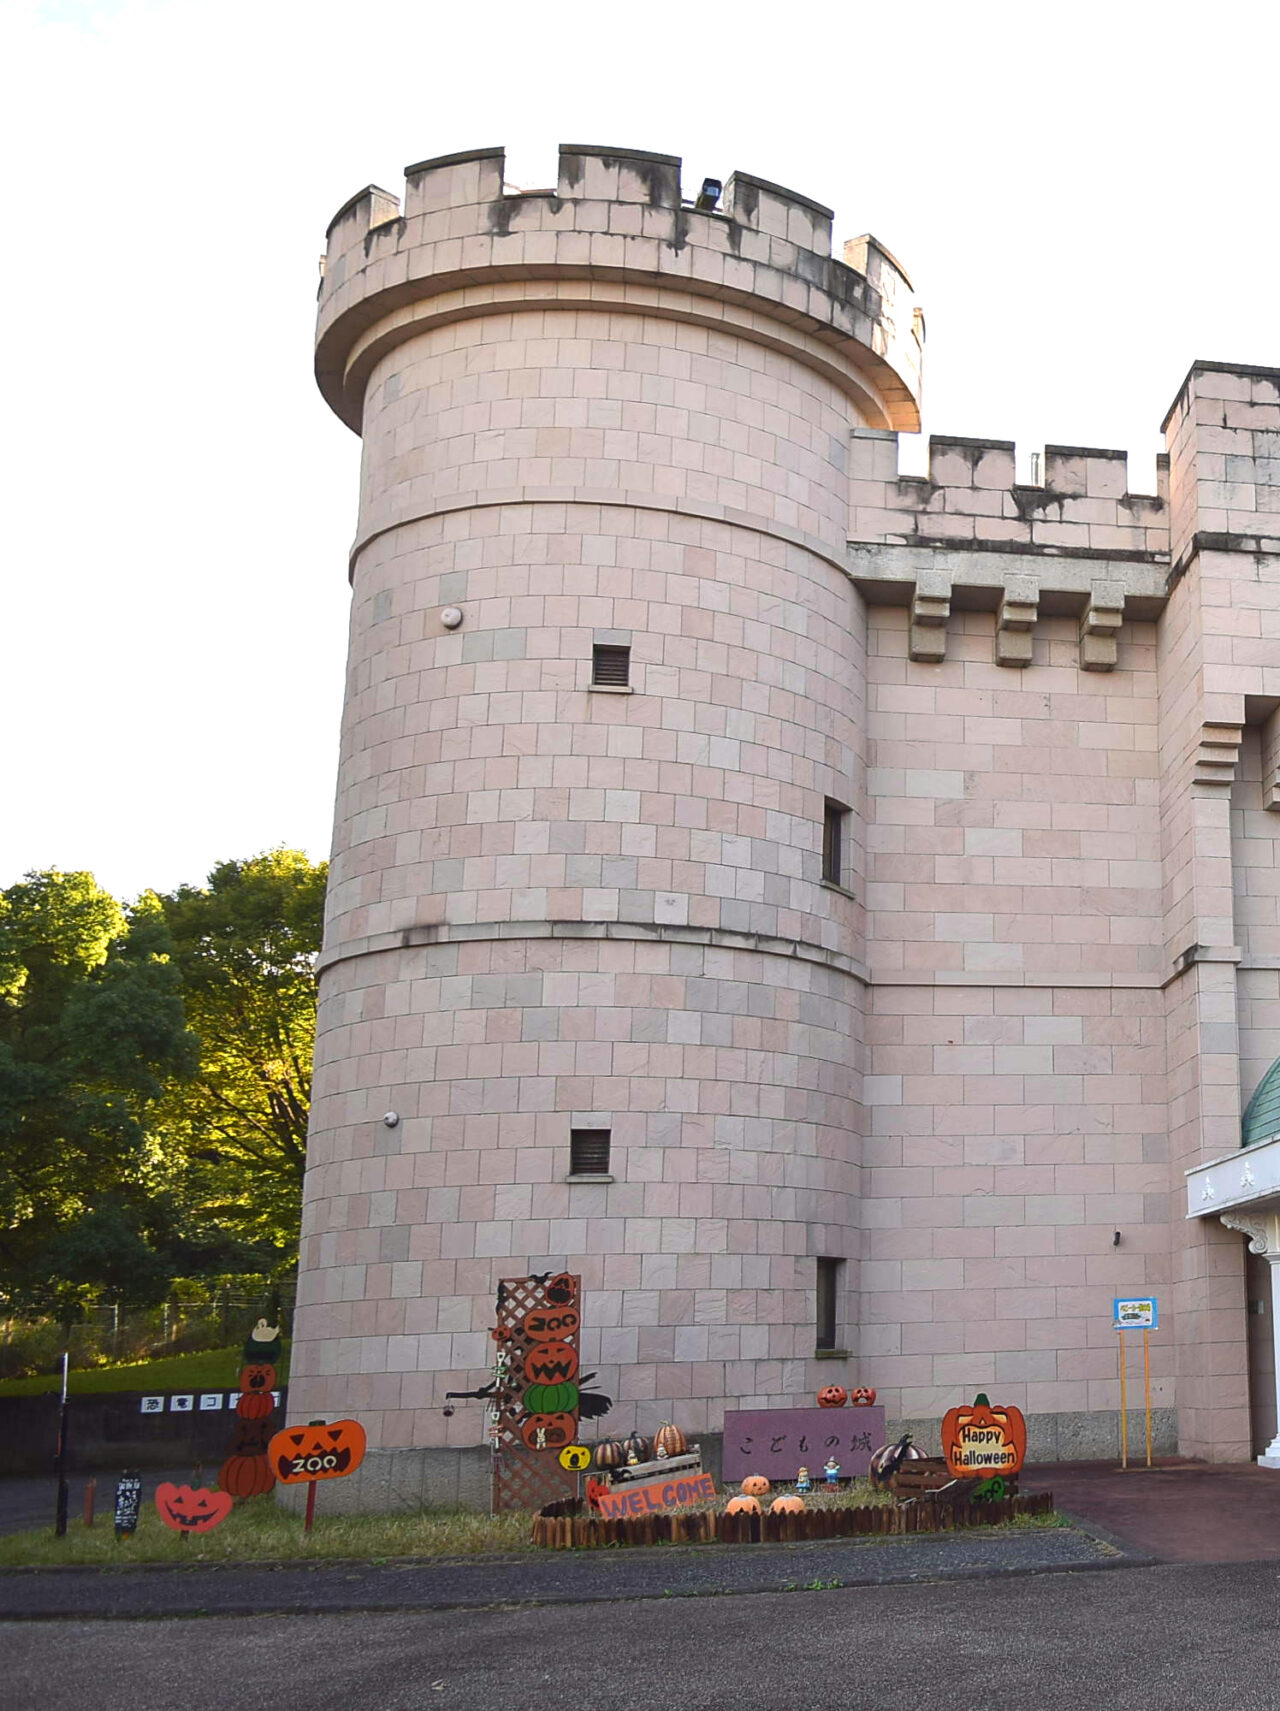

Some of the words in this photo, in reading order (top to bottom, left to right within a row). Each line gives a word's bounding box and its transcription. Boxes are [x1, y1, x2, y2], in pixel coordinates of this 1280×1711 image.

[739, 1431, 873, 1454] こどもの城
[962, 1427, 1002, 1444] Happy
[292, 1455, 337, 1473] ZOO
[954, 1450, 1015, 1466] Halloween
[601, 1478, 714, 1518] WELCOME
